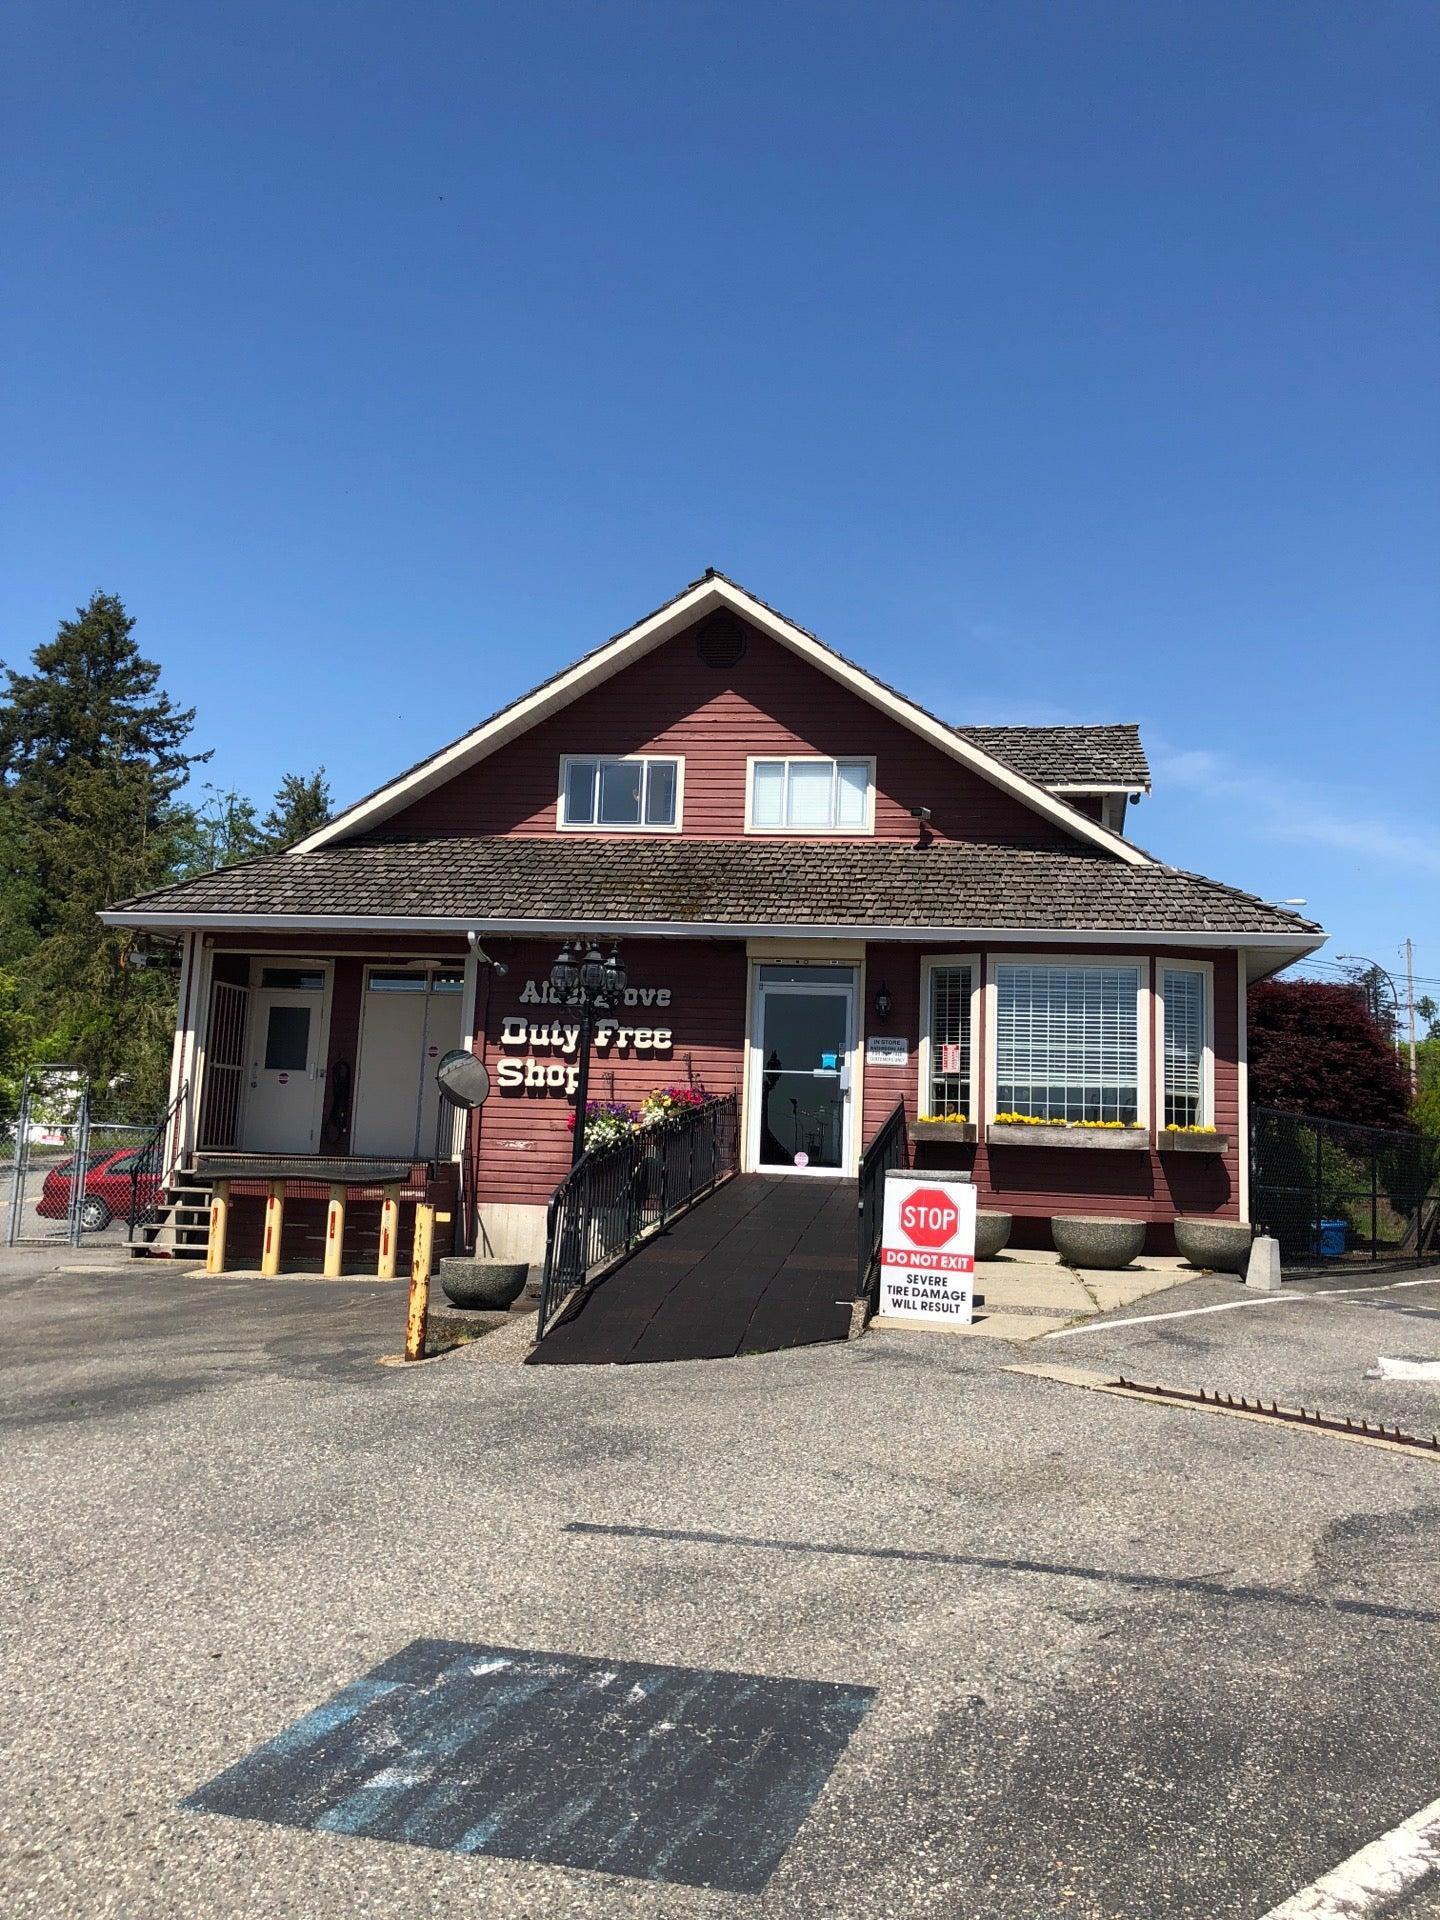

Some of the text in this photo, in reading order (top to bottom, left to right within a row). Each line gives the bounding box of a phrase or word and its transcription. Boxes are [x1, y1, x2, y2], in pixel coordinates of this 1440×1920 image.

[519, 980, 671, 1007] Alove
[501, 1016, 672, 1053] Duty Free
[903, 1205, 956, 1231] STOP
[886, 1251, 969, 1270] DO NOT EXIT
[906, 1273, 948, 1287] SEVERE
[887, 1284, 966, 1302] TIRE DAMAGE
[892, 1298, 961, 1314] WILL RESULT
